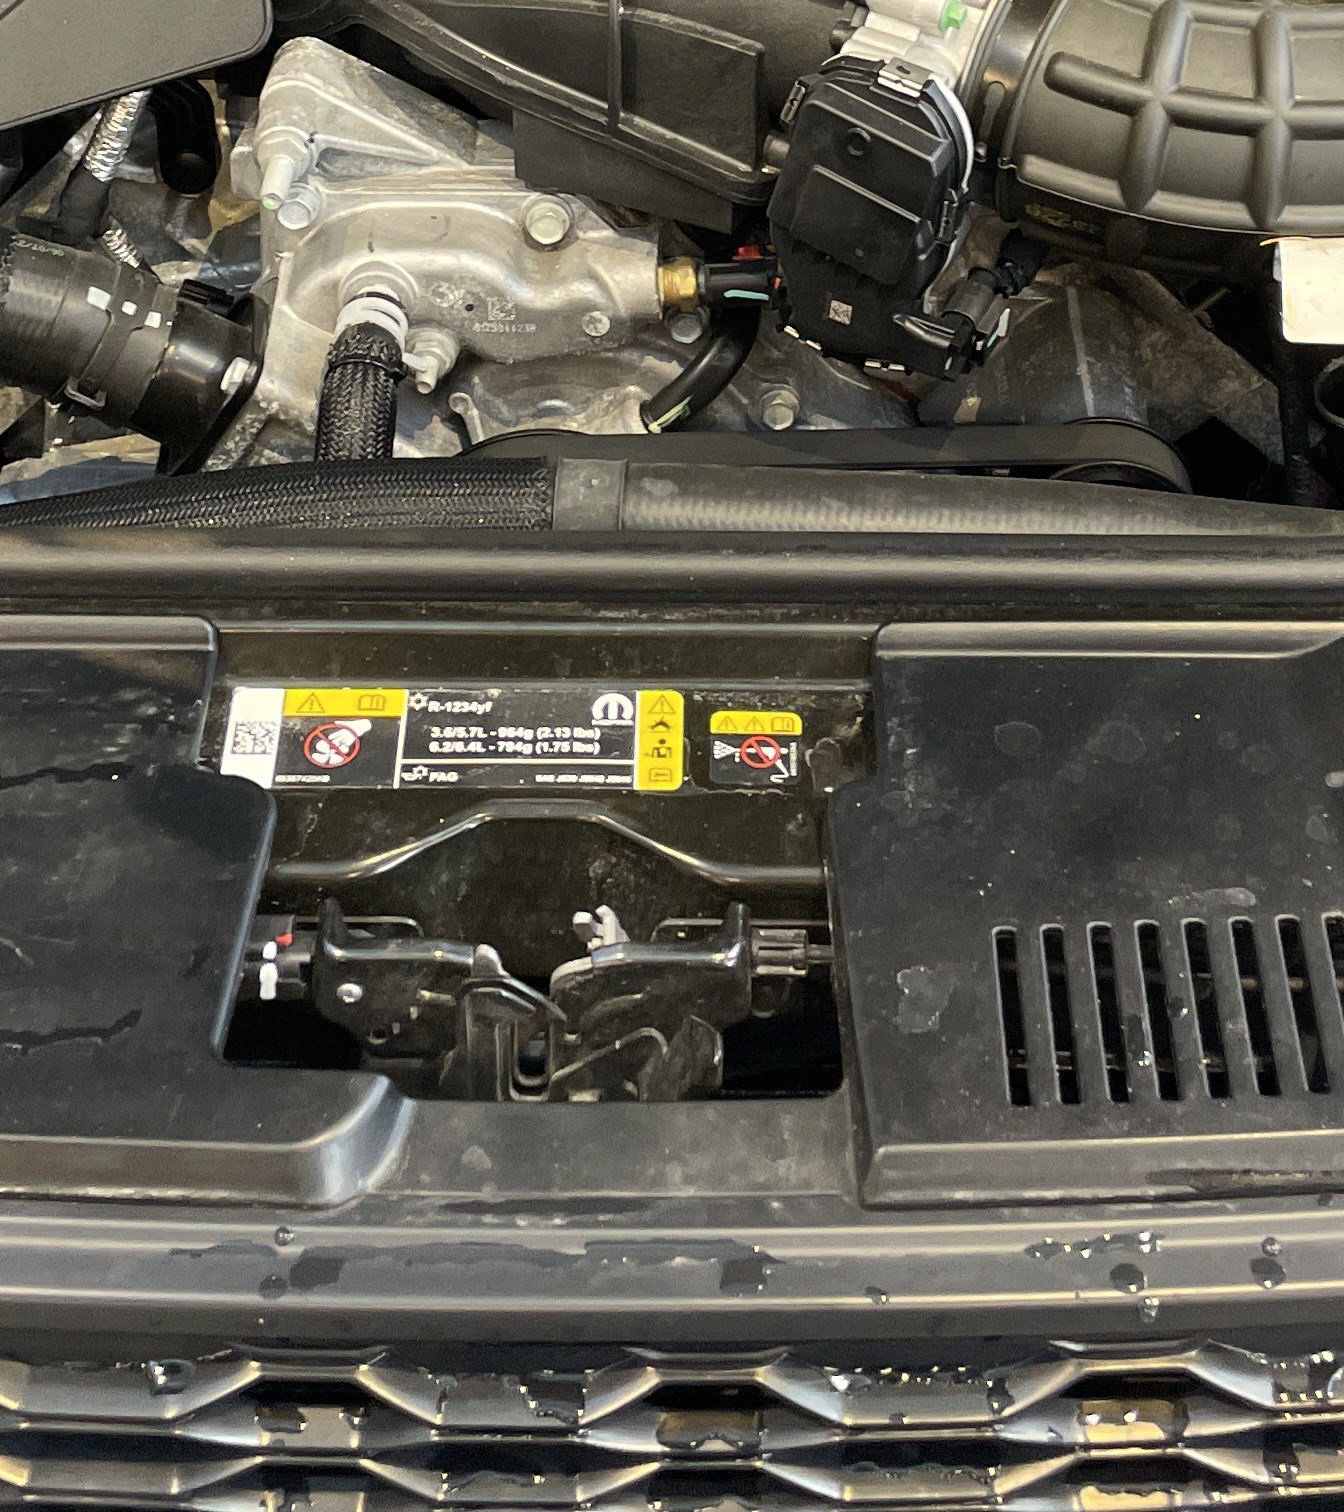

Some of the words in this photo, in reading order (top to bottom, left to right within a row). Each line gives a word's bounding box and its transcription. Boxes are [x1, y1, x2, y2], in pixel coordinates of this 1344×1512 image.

[427, 699, 494, 716] R-1234yf
[536, 726, 572, 741] (2.13
[573, 726, 601, 741] lbs)
[496, 741, 533, 755] 794g
[535, 741, 571, 755] (1.75
[572, 741, 601, 756] lbs)
[428, 771, 459, 784] PAG
